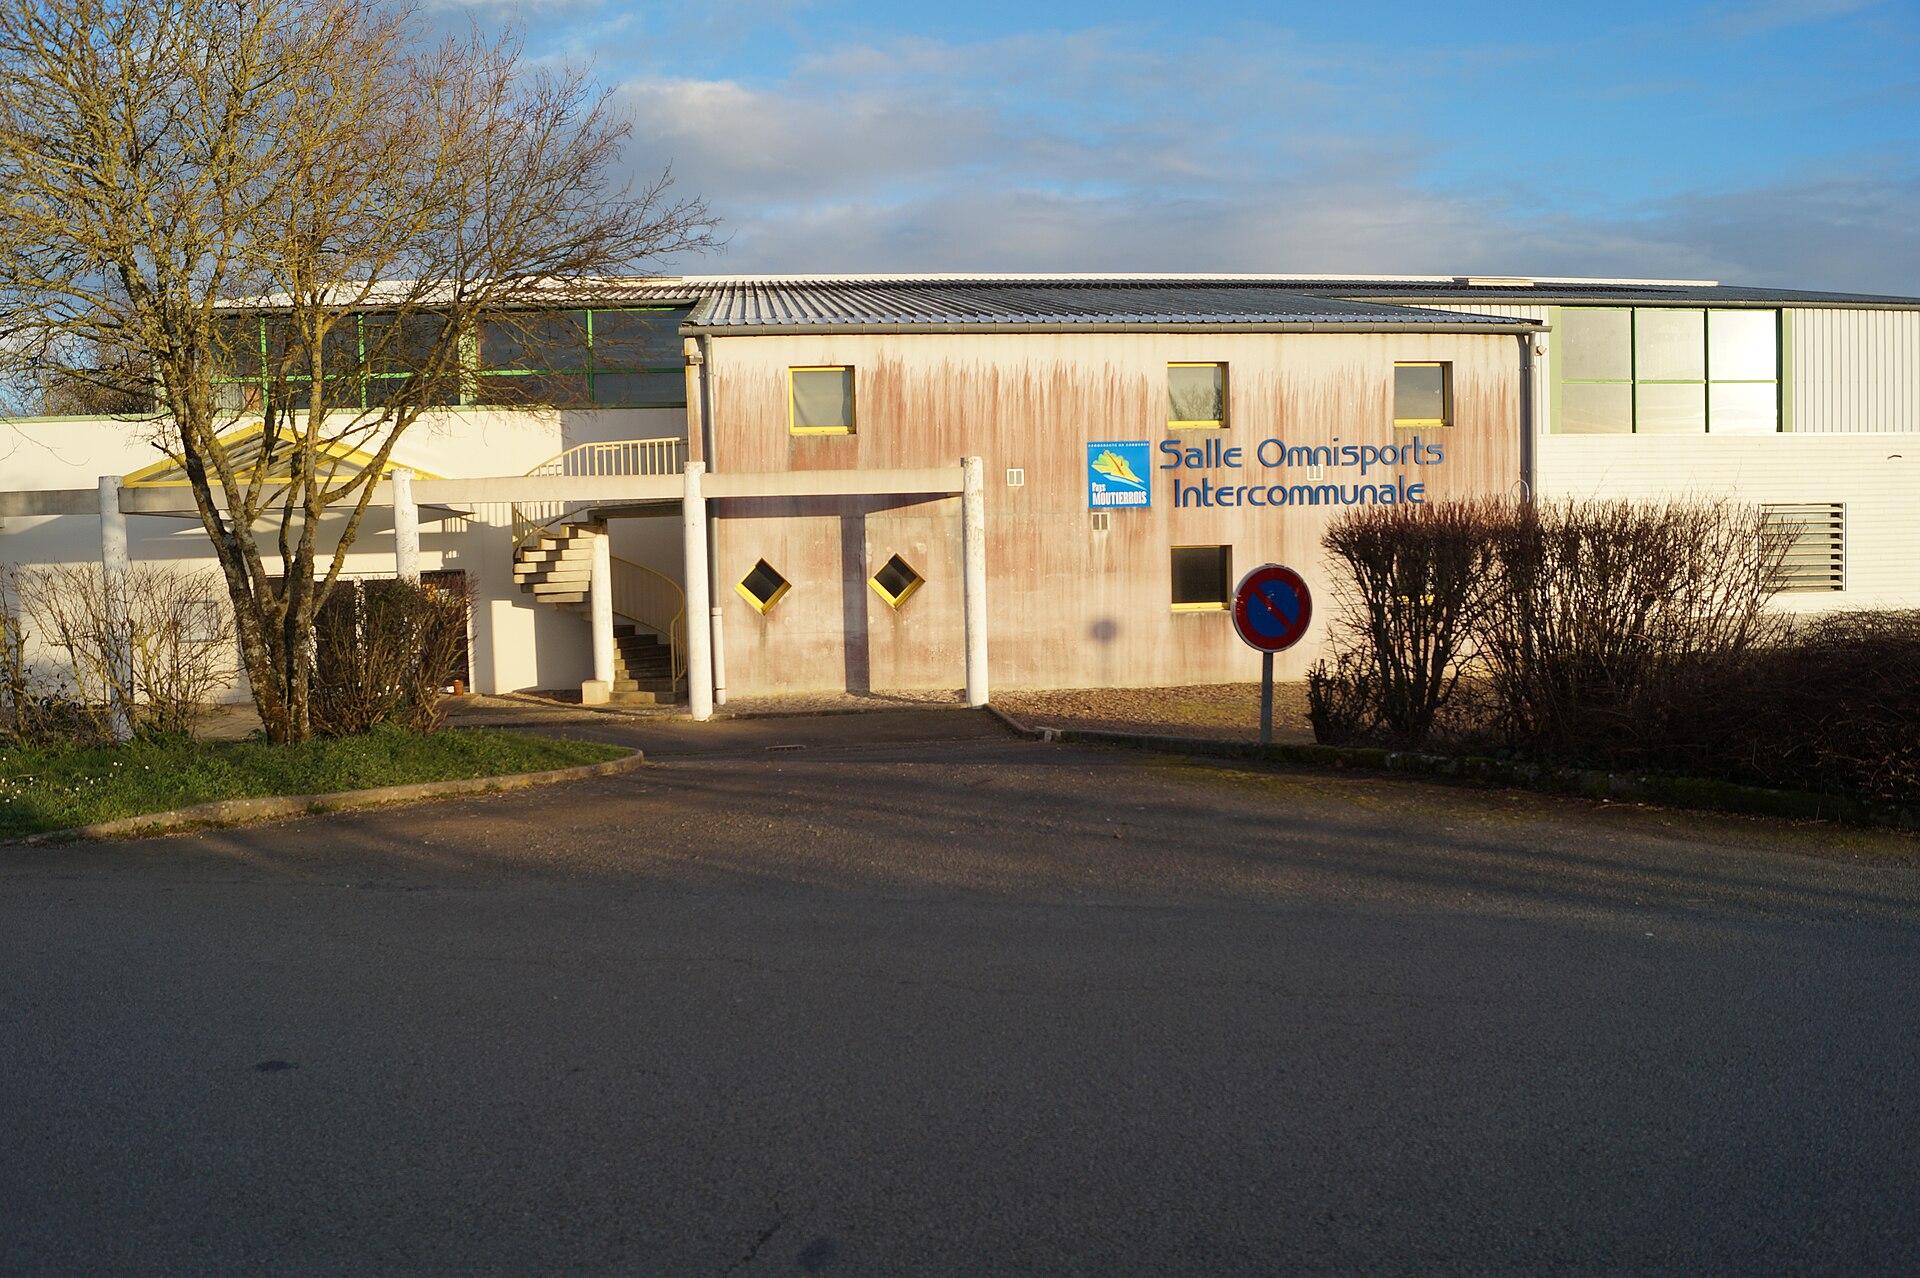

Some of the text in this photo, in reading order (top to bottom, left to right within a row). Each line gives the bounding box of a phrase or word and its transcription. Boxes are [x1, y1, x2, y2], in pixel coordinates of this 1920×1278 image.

[1160, 436, 1445, 476] Salle Omnisports
[1174, 475, 1425, 508] Intercommunale
